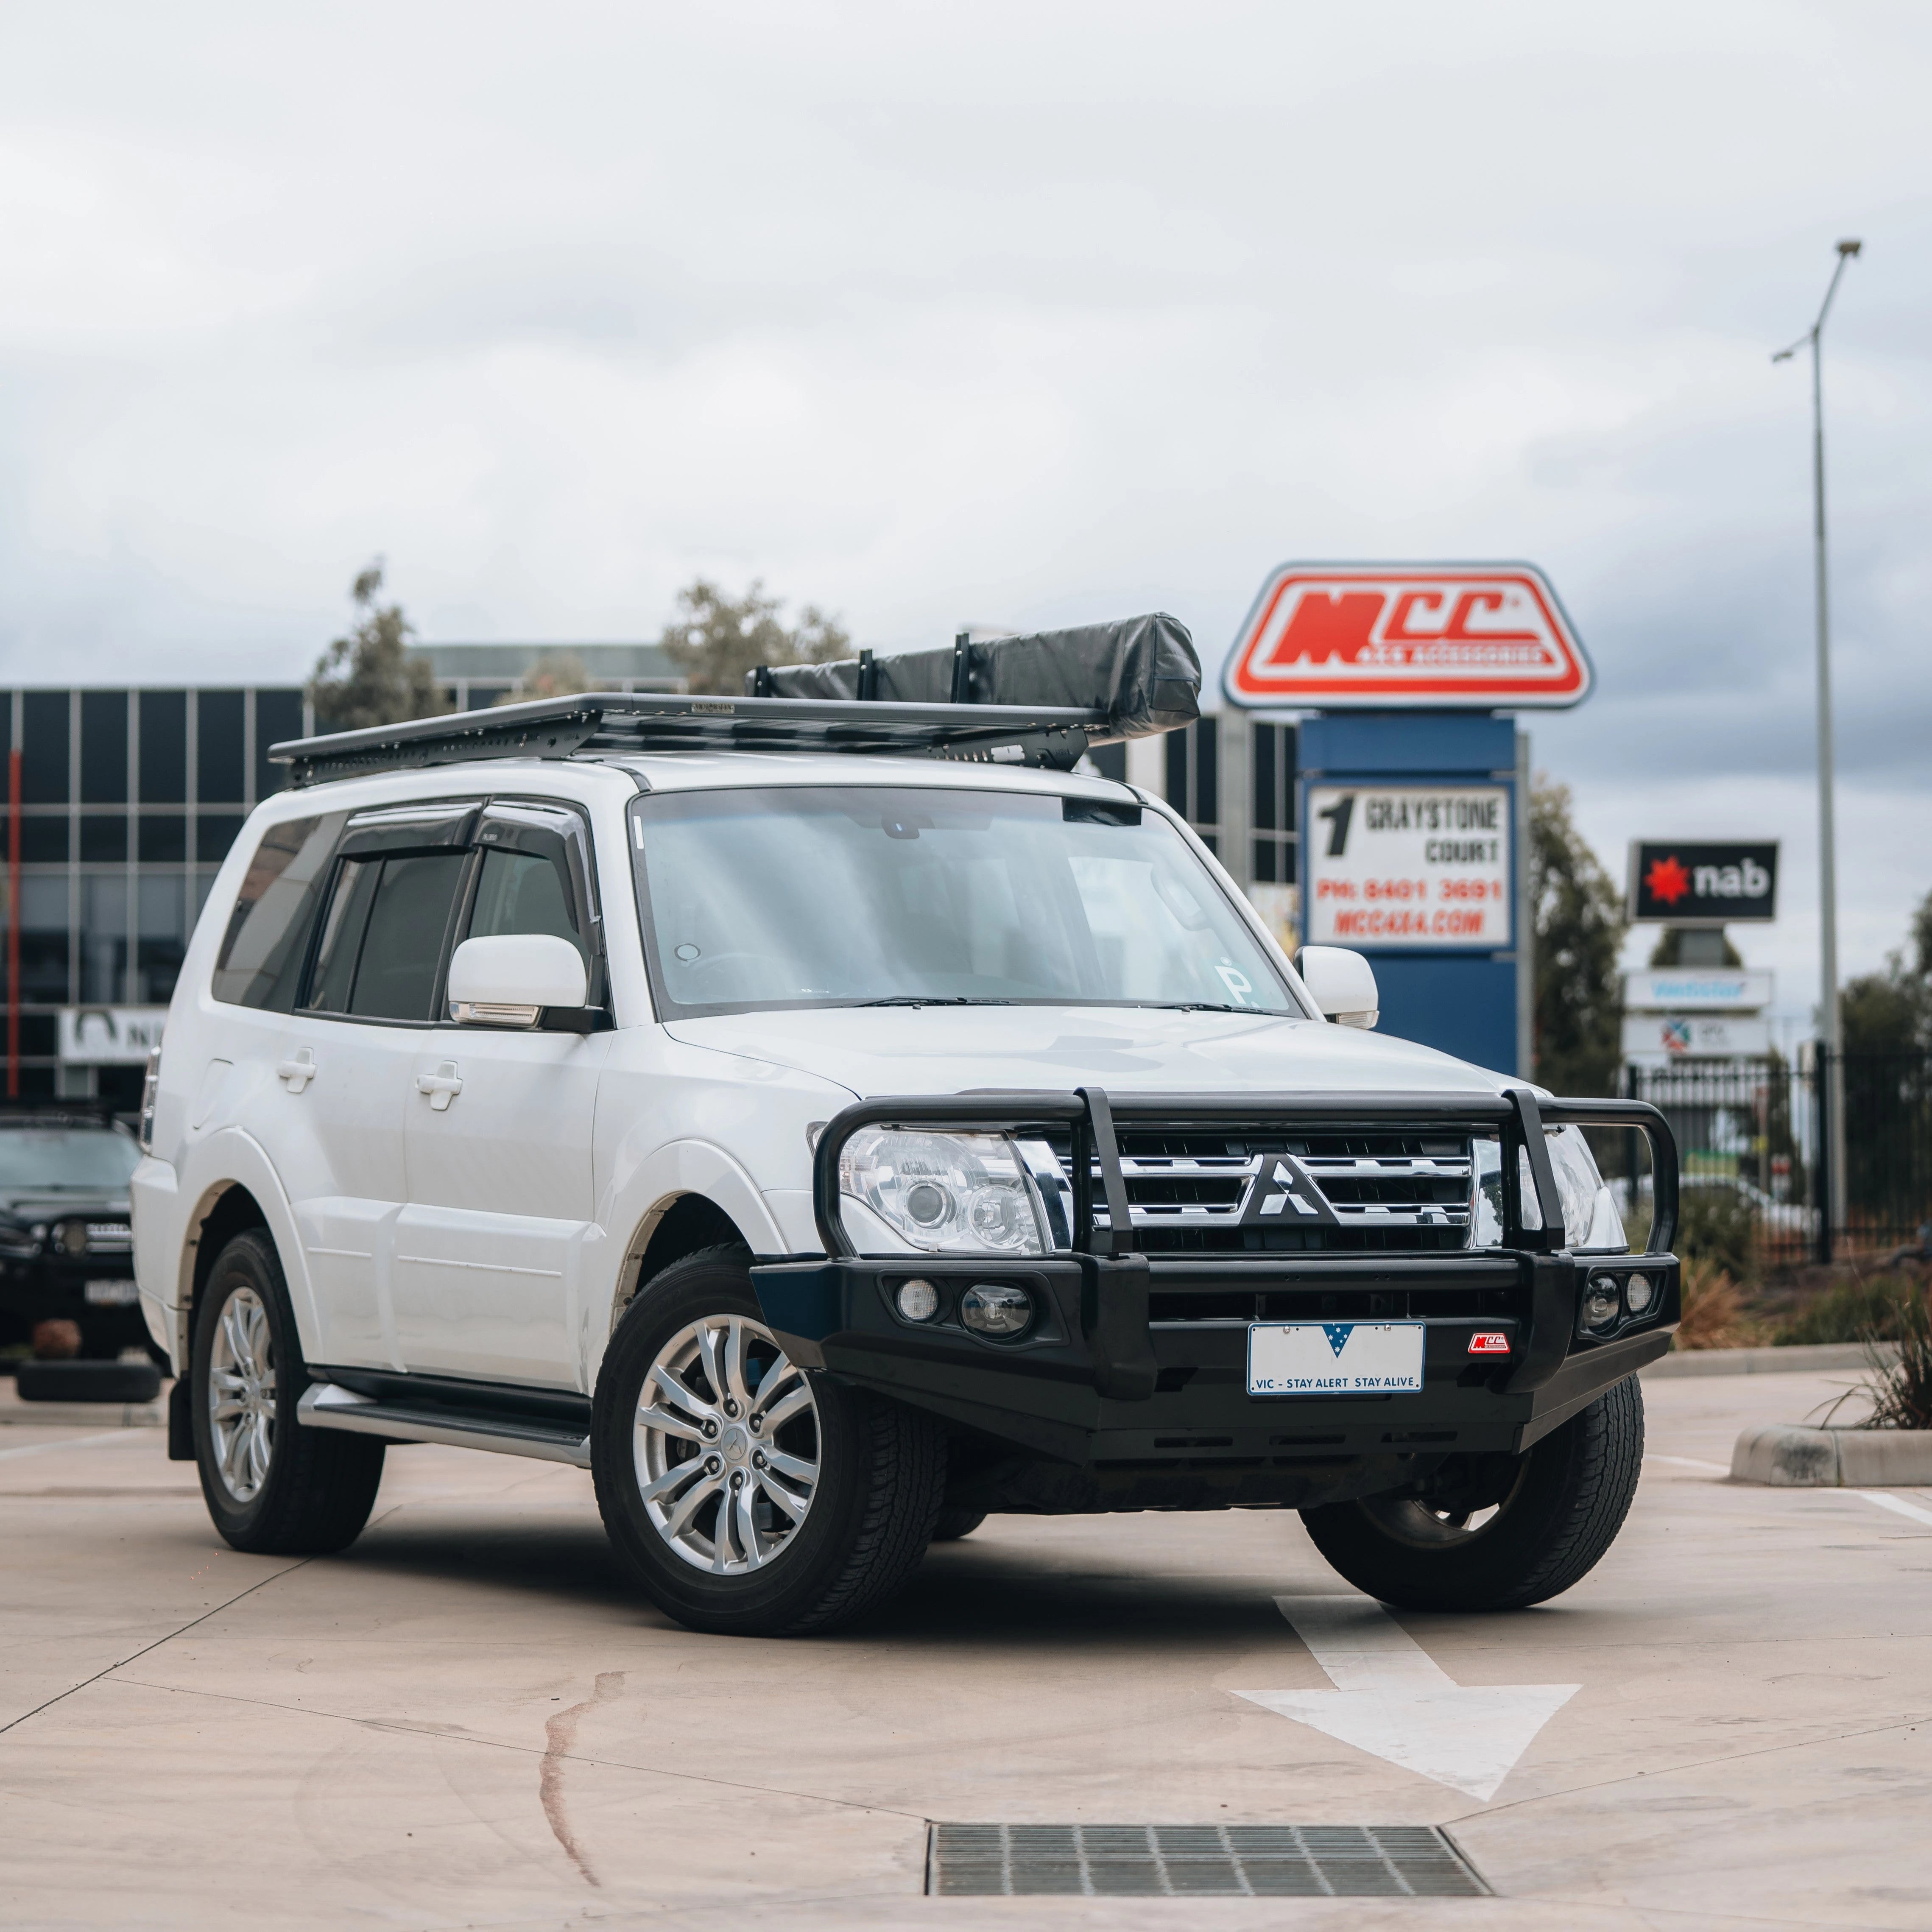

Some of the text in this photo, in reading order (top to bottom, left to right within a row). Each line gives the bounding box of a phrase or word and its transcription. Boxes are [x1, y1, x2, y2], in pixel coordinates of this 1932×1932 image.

[1263, 590, 1542, 664] MCC
[1318, 792, 1498, 857] 1 GRAYSTONE
[1425, 839, 1498, 864] COURT
[1693, 857, 1771, 899] nab
[1214, 965, 1252, 1005] P
[1473, 1336, 1505, 1348] MCC
[1256, 1379, 1274, 1389] VIC
[1287, 1378, 1313, 1388] STAY
[1315, 1377, 1348, 1388] ALERT
[1355, 1377, 1382, 1387] STAY
[1383, 1376, 1414, 1387] ALIVE
